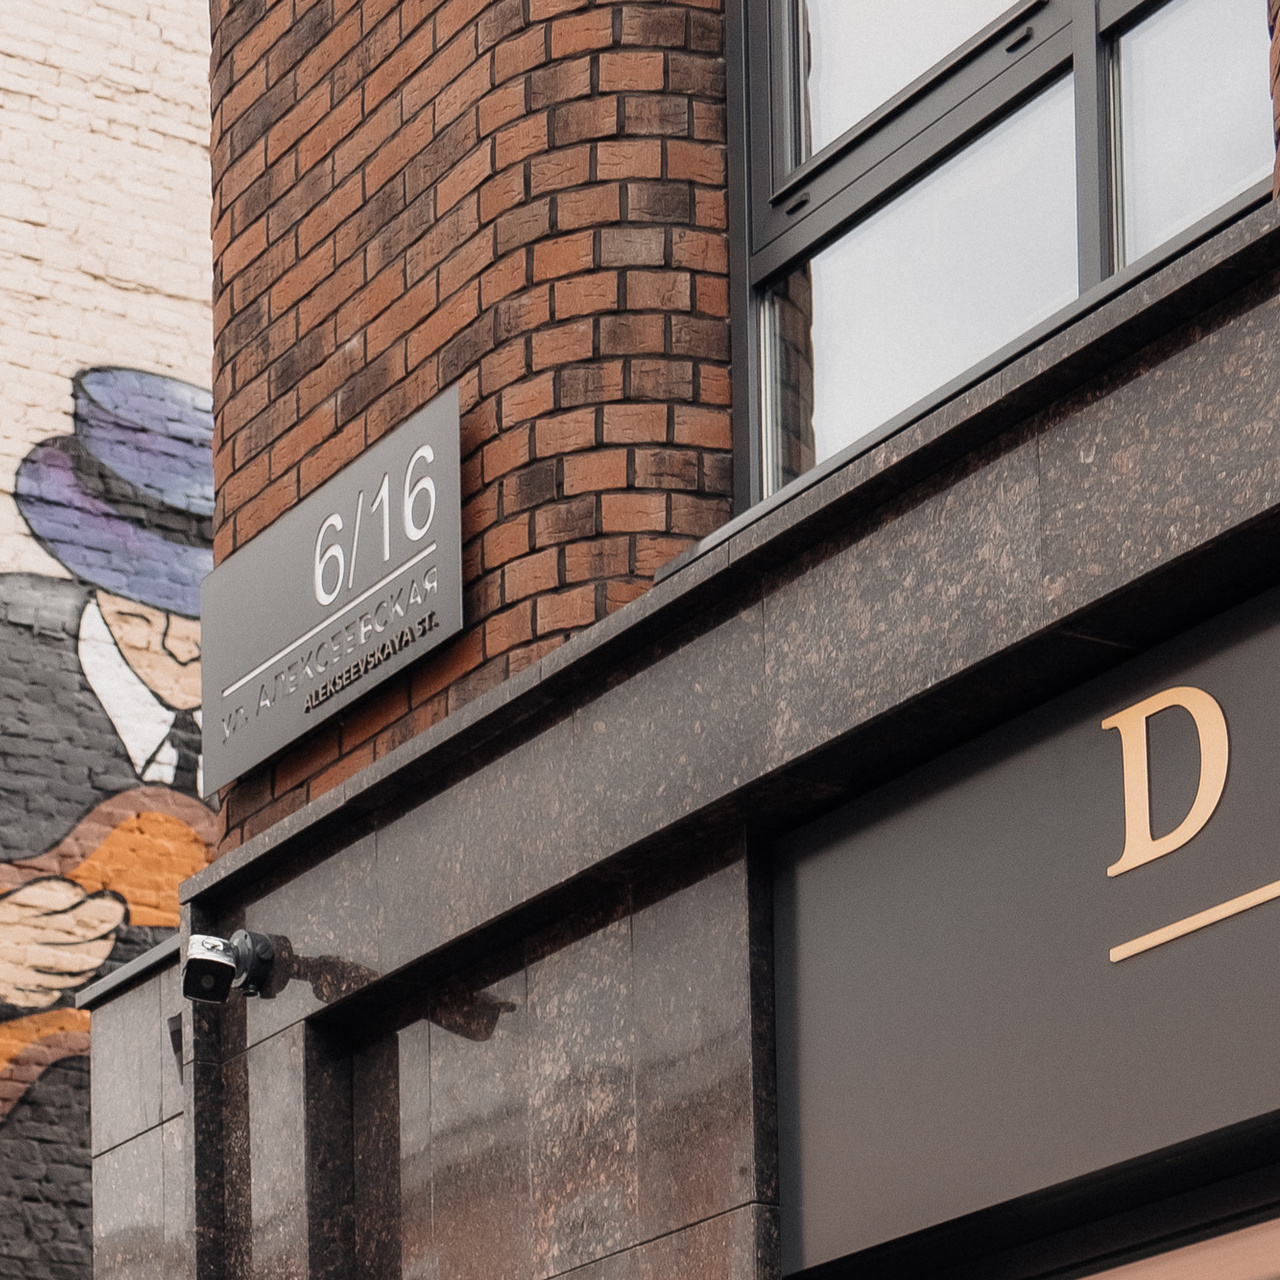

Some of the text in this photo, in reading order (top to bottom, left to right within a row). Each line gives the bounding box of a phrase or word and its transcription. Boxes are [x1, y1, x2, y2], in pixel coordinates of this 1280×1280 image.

[314, 444, 437, 606] 6/16
[256, 564, 439, 717] АЛЕКСЕЕВСКАЯ
[304, 610, 440, 714] ALEKSEEVSKAYA ST.
[1101, 686, 1230, 878] D
